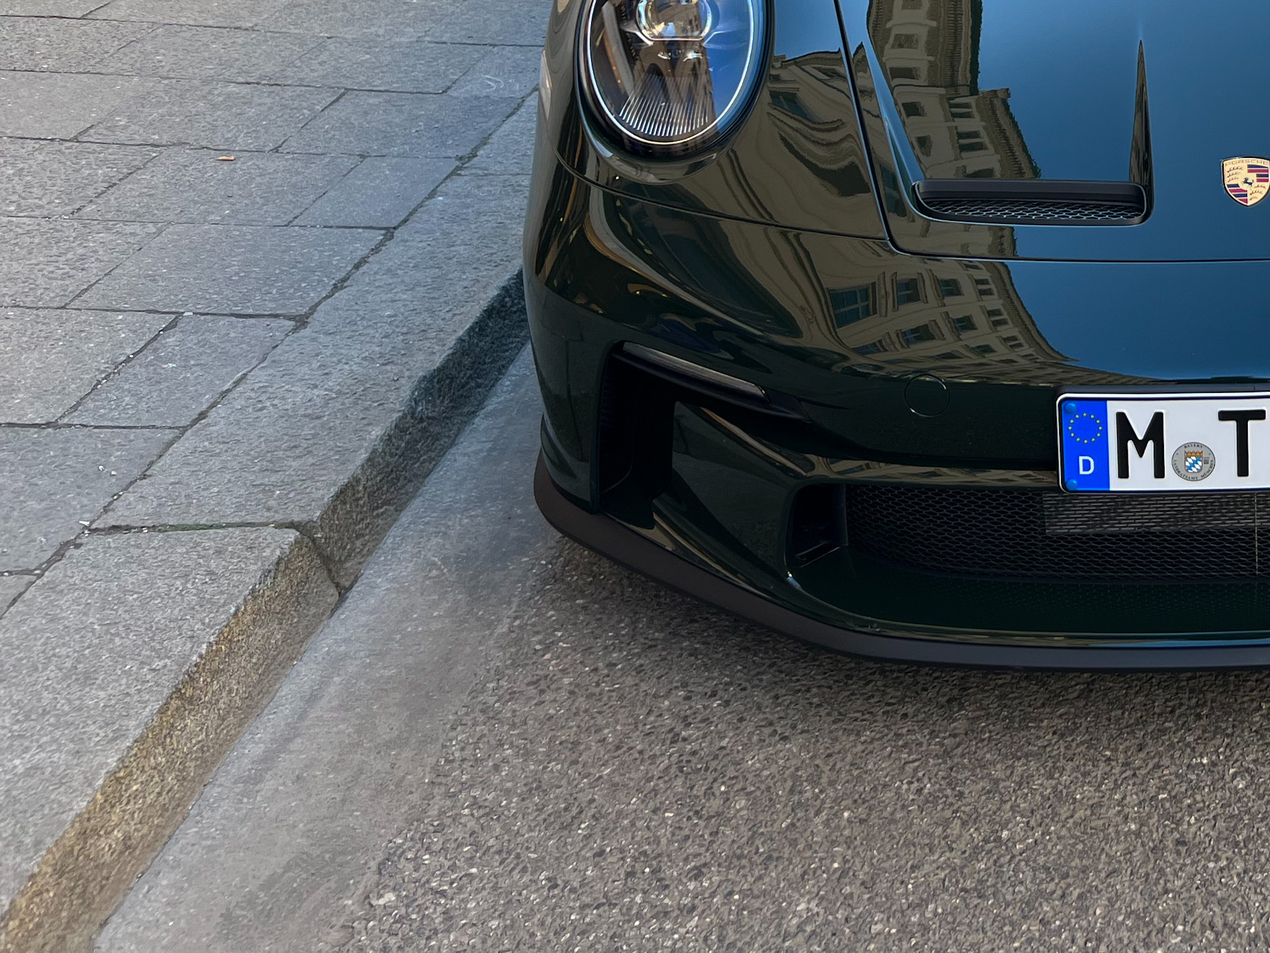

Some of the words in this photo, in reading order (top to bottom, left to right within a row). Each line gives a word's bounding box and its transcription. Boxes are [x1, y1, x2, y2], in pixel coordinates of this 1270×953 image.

[1224, 158, 1269, 167] PORSCHE
[1115, 411, 1165, 479] M
[1078, 455, 1095, 475] D
